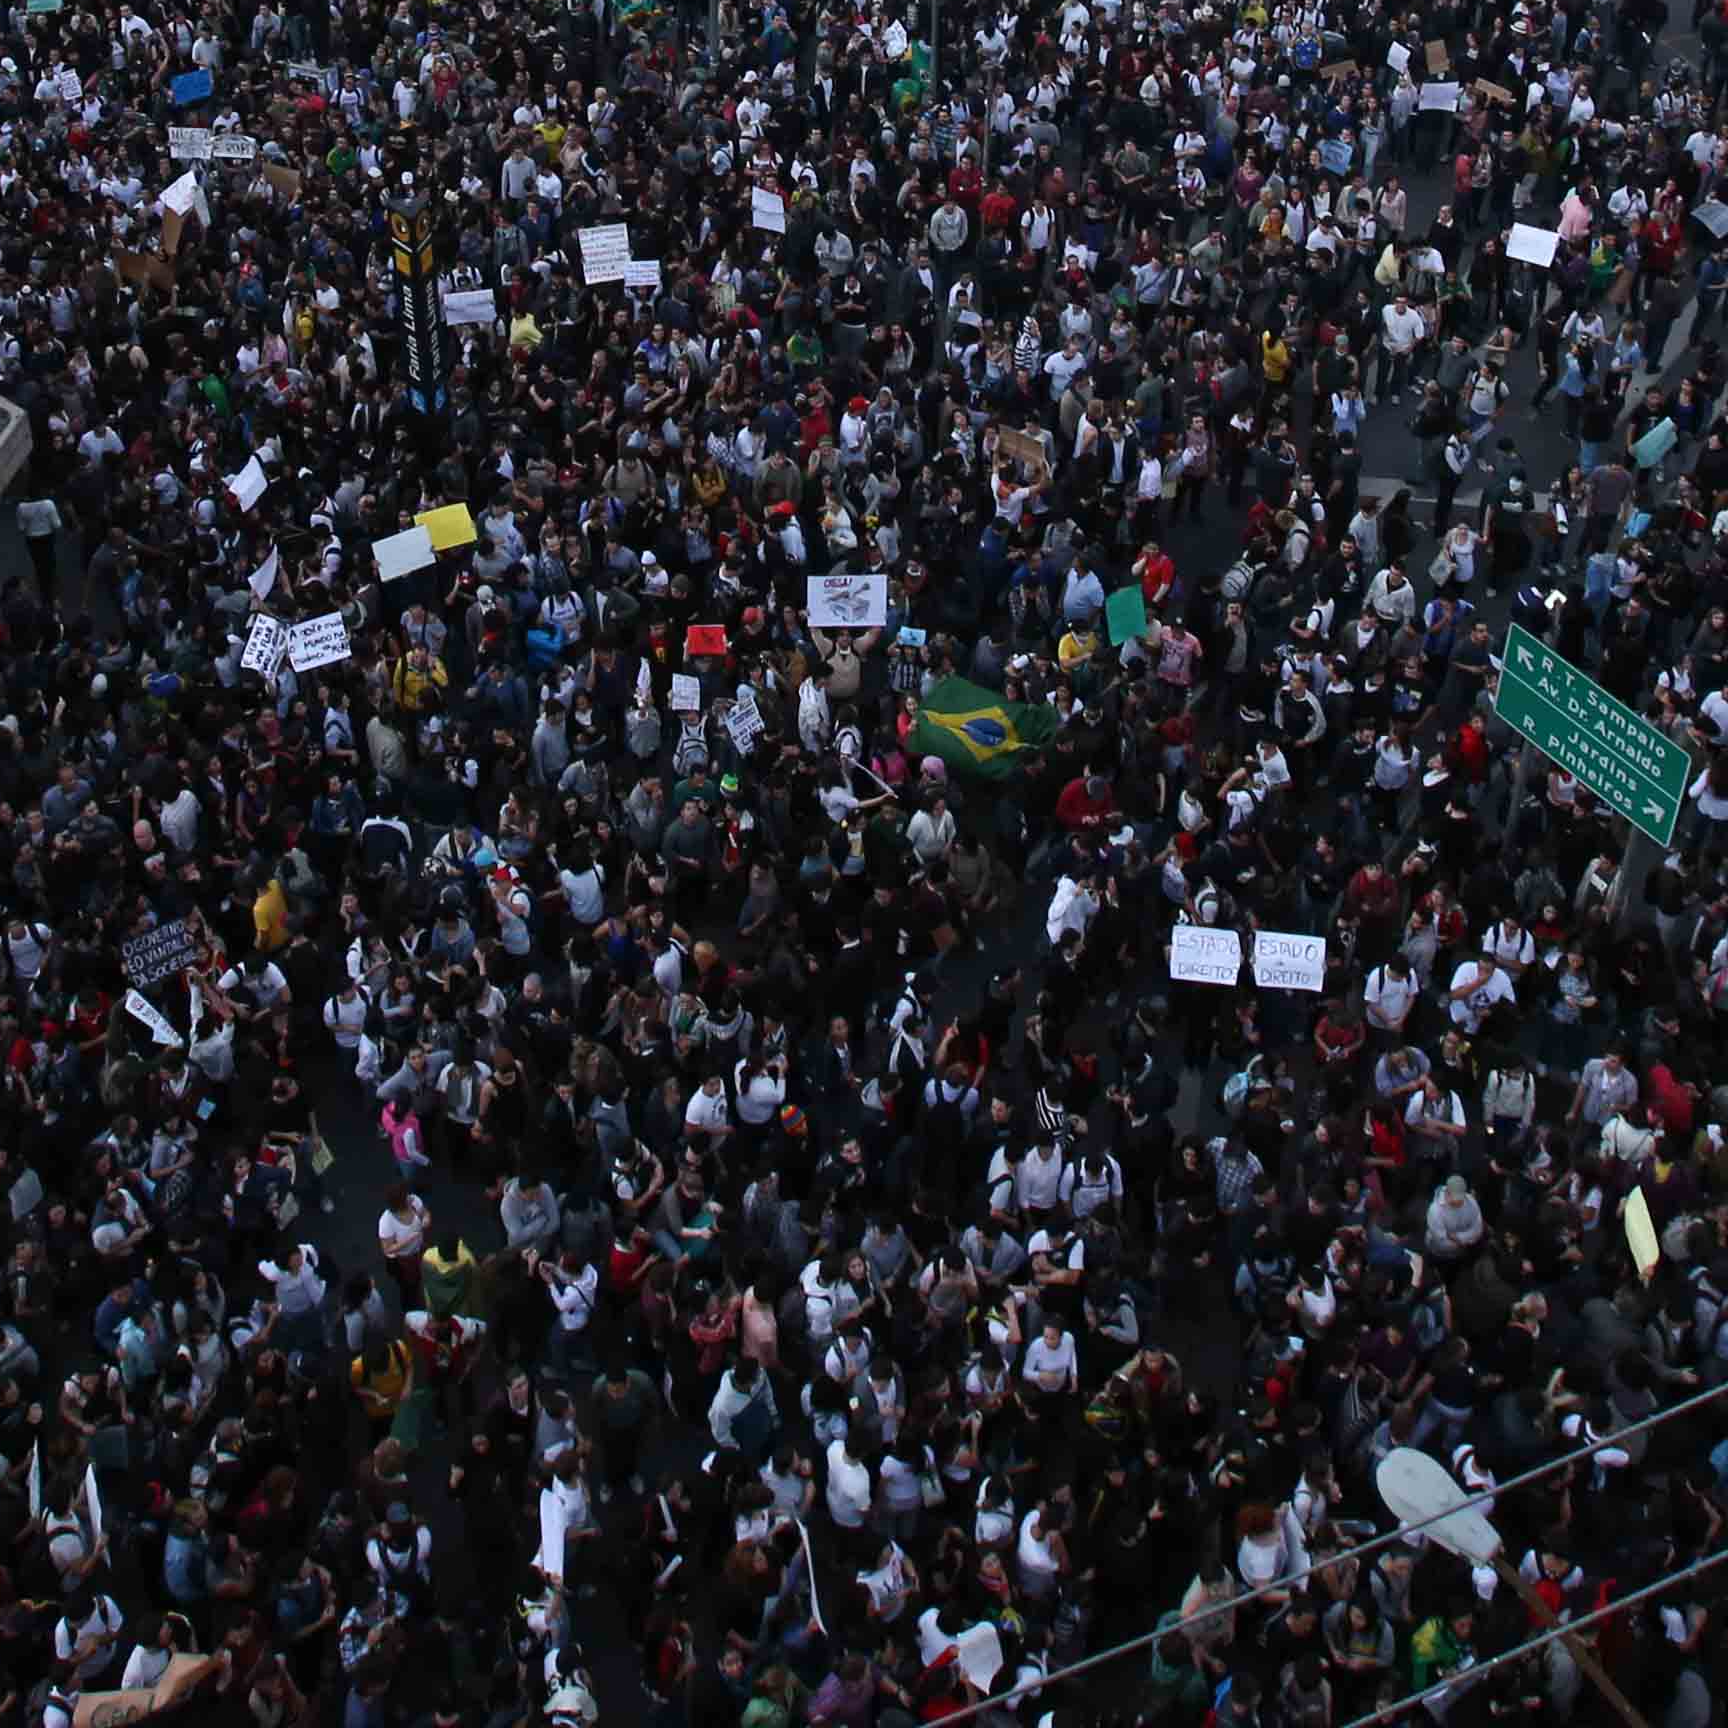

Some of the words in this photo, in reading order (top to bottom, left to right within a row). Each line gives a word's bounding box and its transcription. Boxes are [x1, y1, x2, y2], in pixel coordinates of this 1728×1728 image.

[402, 285, 416, 332] Lima
[406, 335, 422, 382] Faria
[1537, 677, 1560, 702] Av.
[1567, 698, 1589, 723] Dr.
[1593, 721, 1662, 778] Arnaldo
[1587, 689, 1665, 759] Sampaio
[1548, 735, 1633, 811] Pinheiros
[1568, 732, 1638, 791] Jardins
[1176, 935, 1239, 955] ESTADO
[1259, 939, 1319, 962] ESTADO
[1260, 968, 1311, 986] DIREITO
